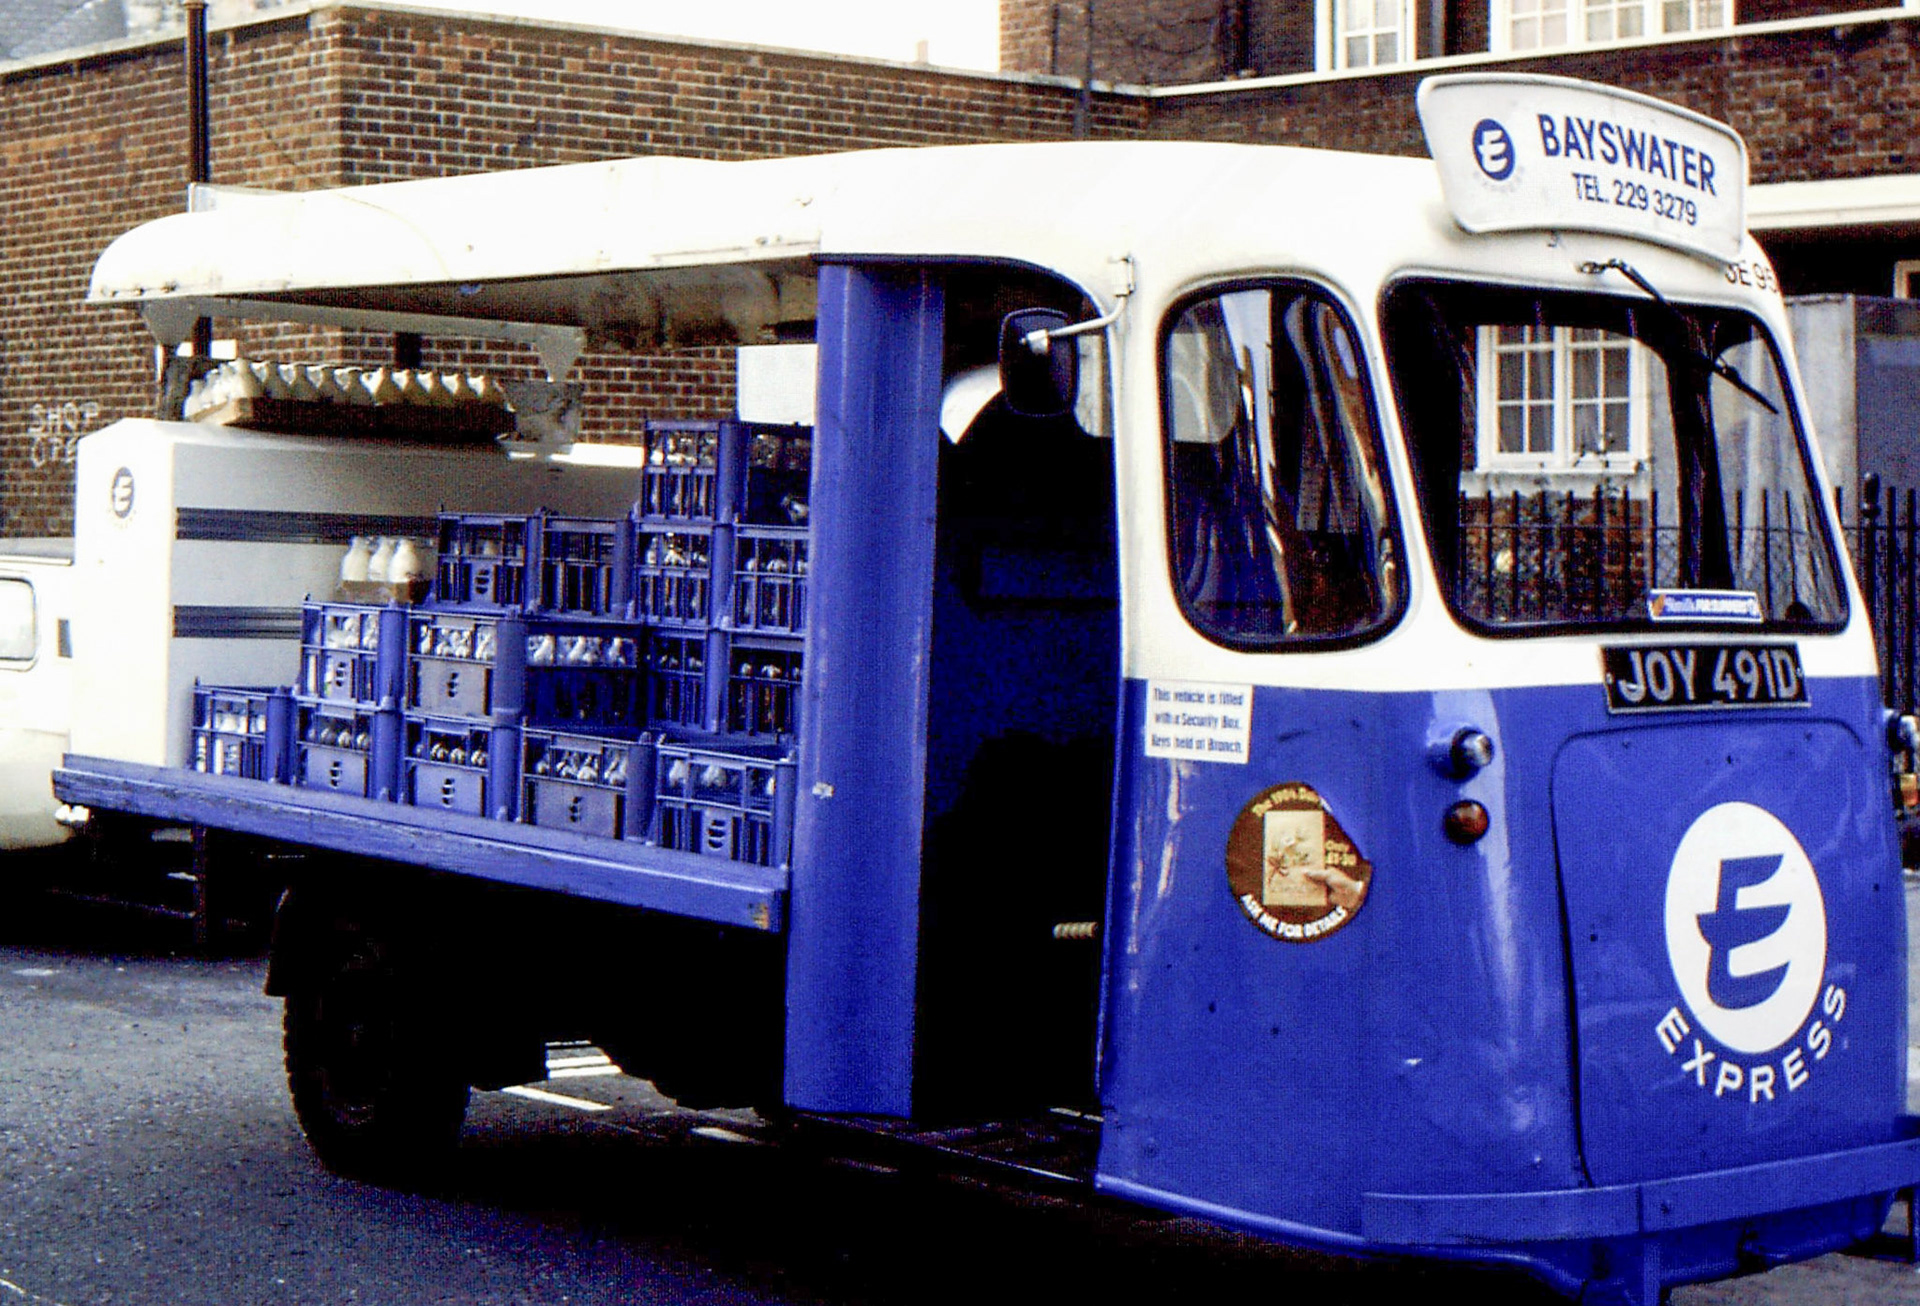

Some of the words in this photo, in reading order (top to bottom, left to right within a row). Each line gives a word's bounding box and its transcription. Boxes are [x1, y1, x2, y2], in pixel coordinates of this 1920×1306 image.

[1537, 113, 1716, 197] BAYSWATER
[1571, 173, 1609, 204] TEL.
[1613, 179, 1649, 212] 229
[1653, 191, 1698, 226] 3279
[1154, 687, 1171, 701] This
[1174, 691, 1205, 703] vehicle
[1219, 693, 1243, 706] fitted
[1617, 649, 1696, 702] JOY
[1712, 649, 1799, 700] 491D
[1151, 734, 1171, 747] Keys
[1174, 737, 1193, 749] held
[1155, 712, 1172, 724] with
[1182, 712, 1219, 729] Security
[1240, 894, 1263, 919] ASK
[1258, 911, 1279, 933] ME
[1277, 921, 1304, 938] FOR
[1304, 905, 1348, 937] DETAILS
[1655, 984, 1847, 1103] EXPRESS
